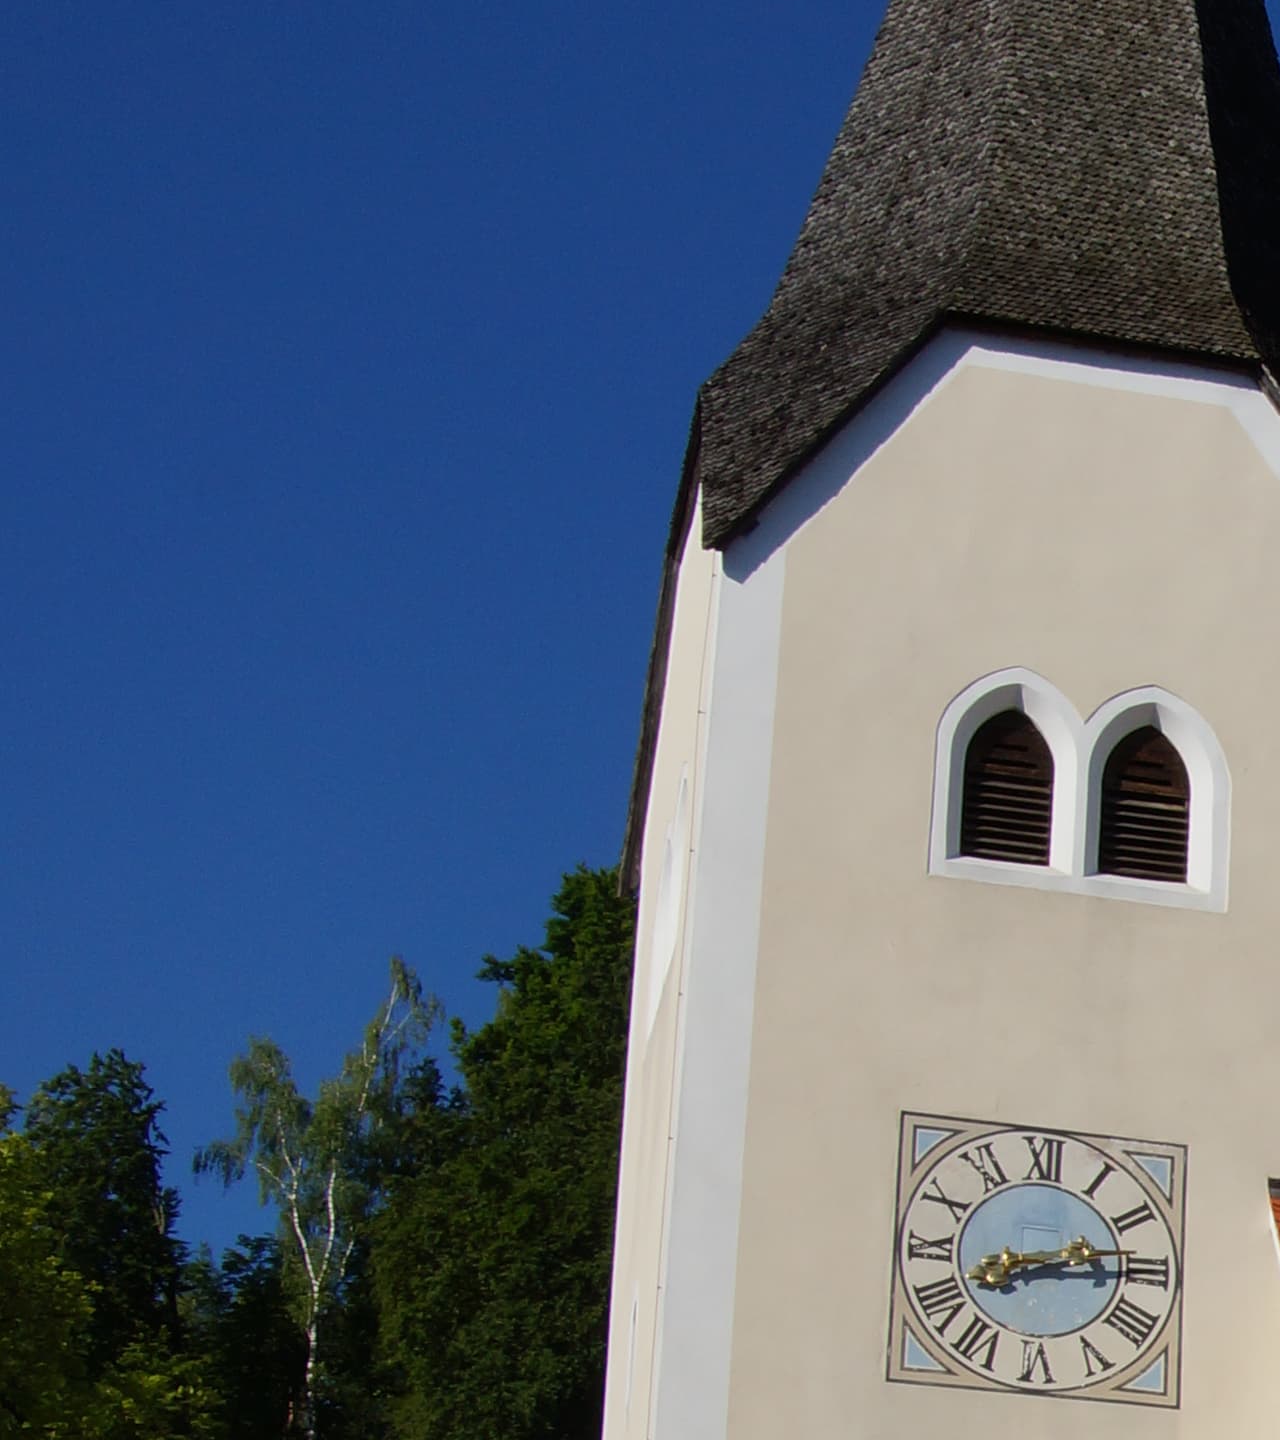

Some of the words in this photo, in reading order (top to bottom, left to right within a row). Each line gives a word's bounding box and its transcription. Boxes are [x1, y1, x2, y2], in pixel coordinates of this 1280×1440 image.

[958, 1142, 1011, 1194] XI
[1022, 1135, 1066, 1184] XII
[1081, 1161, 1117, 1200] I
[920, 1177, 972, 1224] X
[1110, 1199, 1157, 1236] II
[908, 1229, 955, 1263] IX
[1124, 1252, 1168, 1292] III
[913, 1273, 967, 1337] VIII
[1101, 1293, 1161, 1350] IIII
[950, 1313, 1000, 1372] VII
[1016, 1339, 1056, 1384] VI
[1080, 1335, 1116, 1377] V
